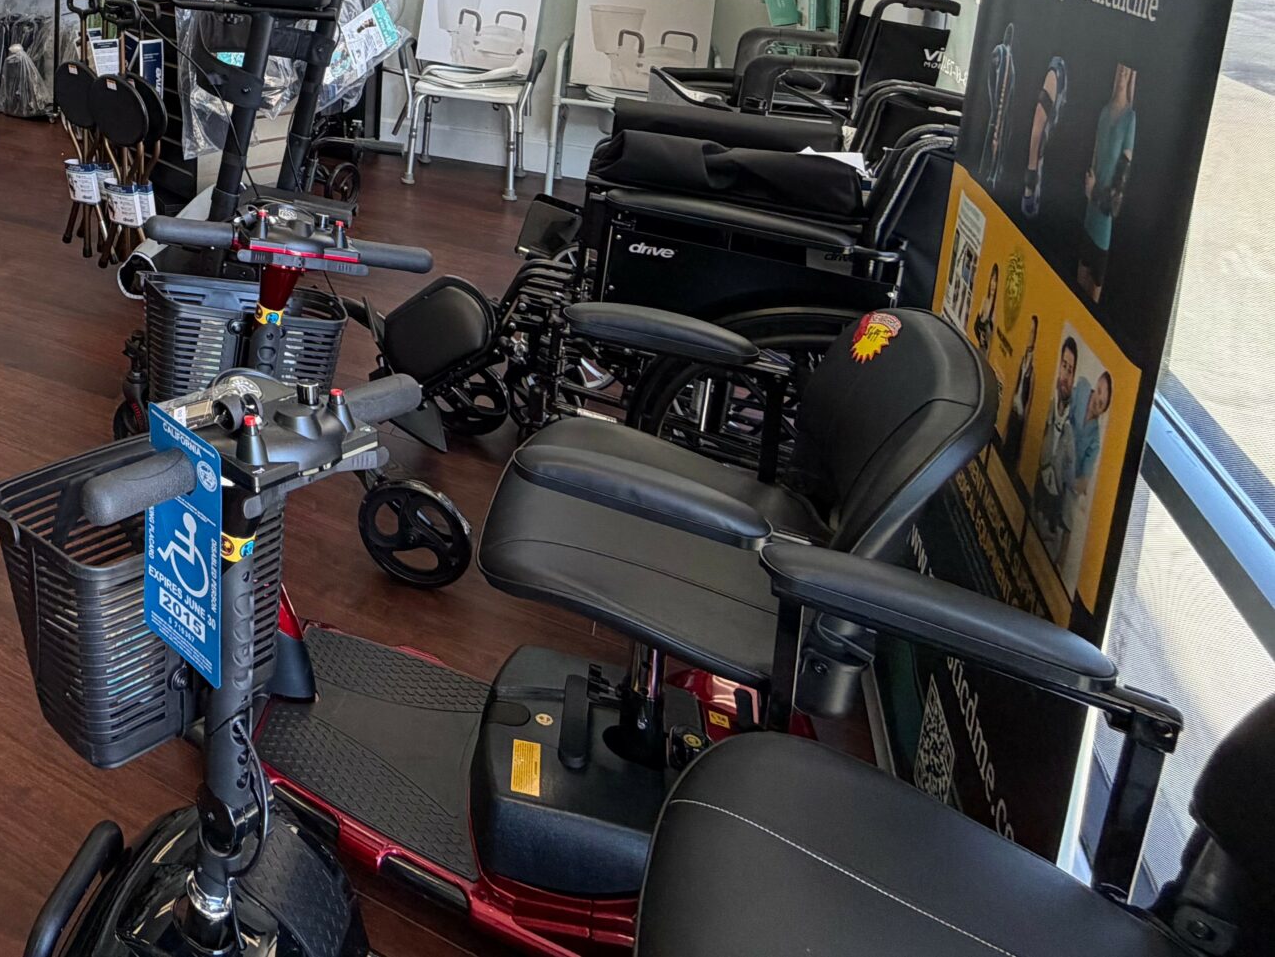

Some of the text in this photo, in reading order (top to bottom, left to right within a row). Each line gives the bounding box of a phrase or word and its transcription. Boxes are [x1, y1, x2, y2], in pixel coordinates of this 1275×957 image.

[628, 242, 675, 259] drive
[162, 422, 202, 458] CALIFORNIA
[147, 524, 155, 560] PLACARD
[210, 538, 218, 614] DISABLED PERSON
[148, 564, 216, 631] EXPIRES JUNE 30
[162, 592, 203, 636] 2015
